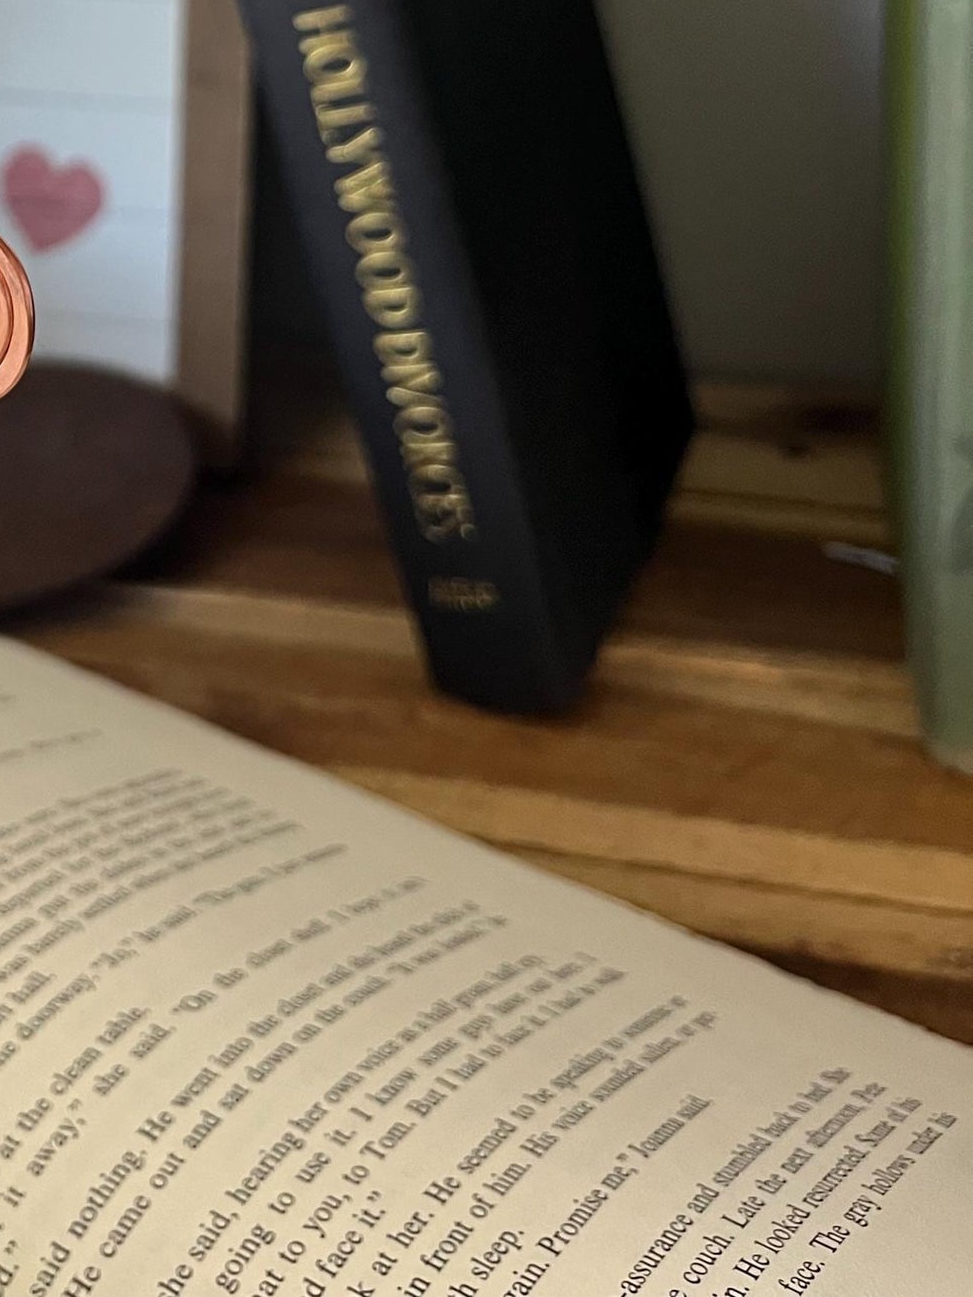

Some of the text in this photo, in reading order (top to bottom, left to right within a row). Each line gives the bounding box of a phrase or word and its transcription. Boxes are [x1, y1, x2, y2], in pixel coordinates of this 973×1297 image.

[291, 3, 425, 327] HOLLYWOOD
[0, 1185, 27, 1208] it
[92, 1063, 130, 1098] she
[14, 1097, 54, 1132] the
[49, 1046, 103, 1097] clean
[29, 1035, 256, 1297] said nothing. He went into
[99, 1041, 299, 1259] came out and sat down
[188, 1070, 364, 1262] said, hearing her own
[215, 1067, 418, 1295] going to use it. I know
[278, 1087, 448, 1264] to you, to Tom. But
[371, 1118, 518, 1277] at her. He seemed
[419, 1100, 595, 1272] front of him. His voice
[535, 1187, 608, 1257] Promise
[627, 1117, 685, 1158] Joanna
[683, 1147, 815, 1285] couch. Late the next
[687, 1183, 720, 1214] and
[712, 1133, 773, 1187] stumbled
[732, 1251, 771, 1282] He
[753, 1203, 812, 1255] looked
[778, 1112, 958, 1297] face. The gray hollows under his
[315, 1229, 365, 1279] face
[471, 1230, 525, 1280] sleep.
